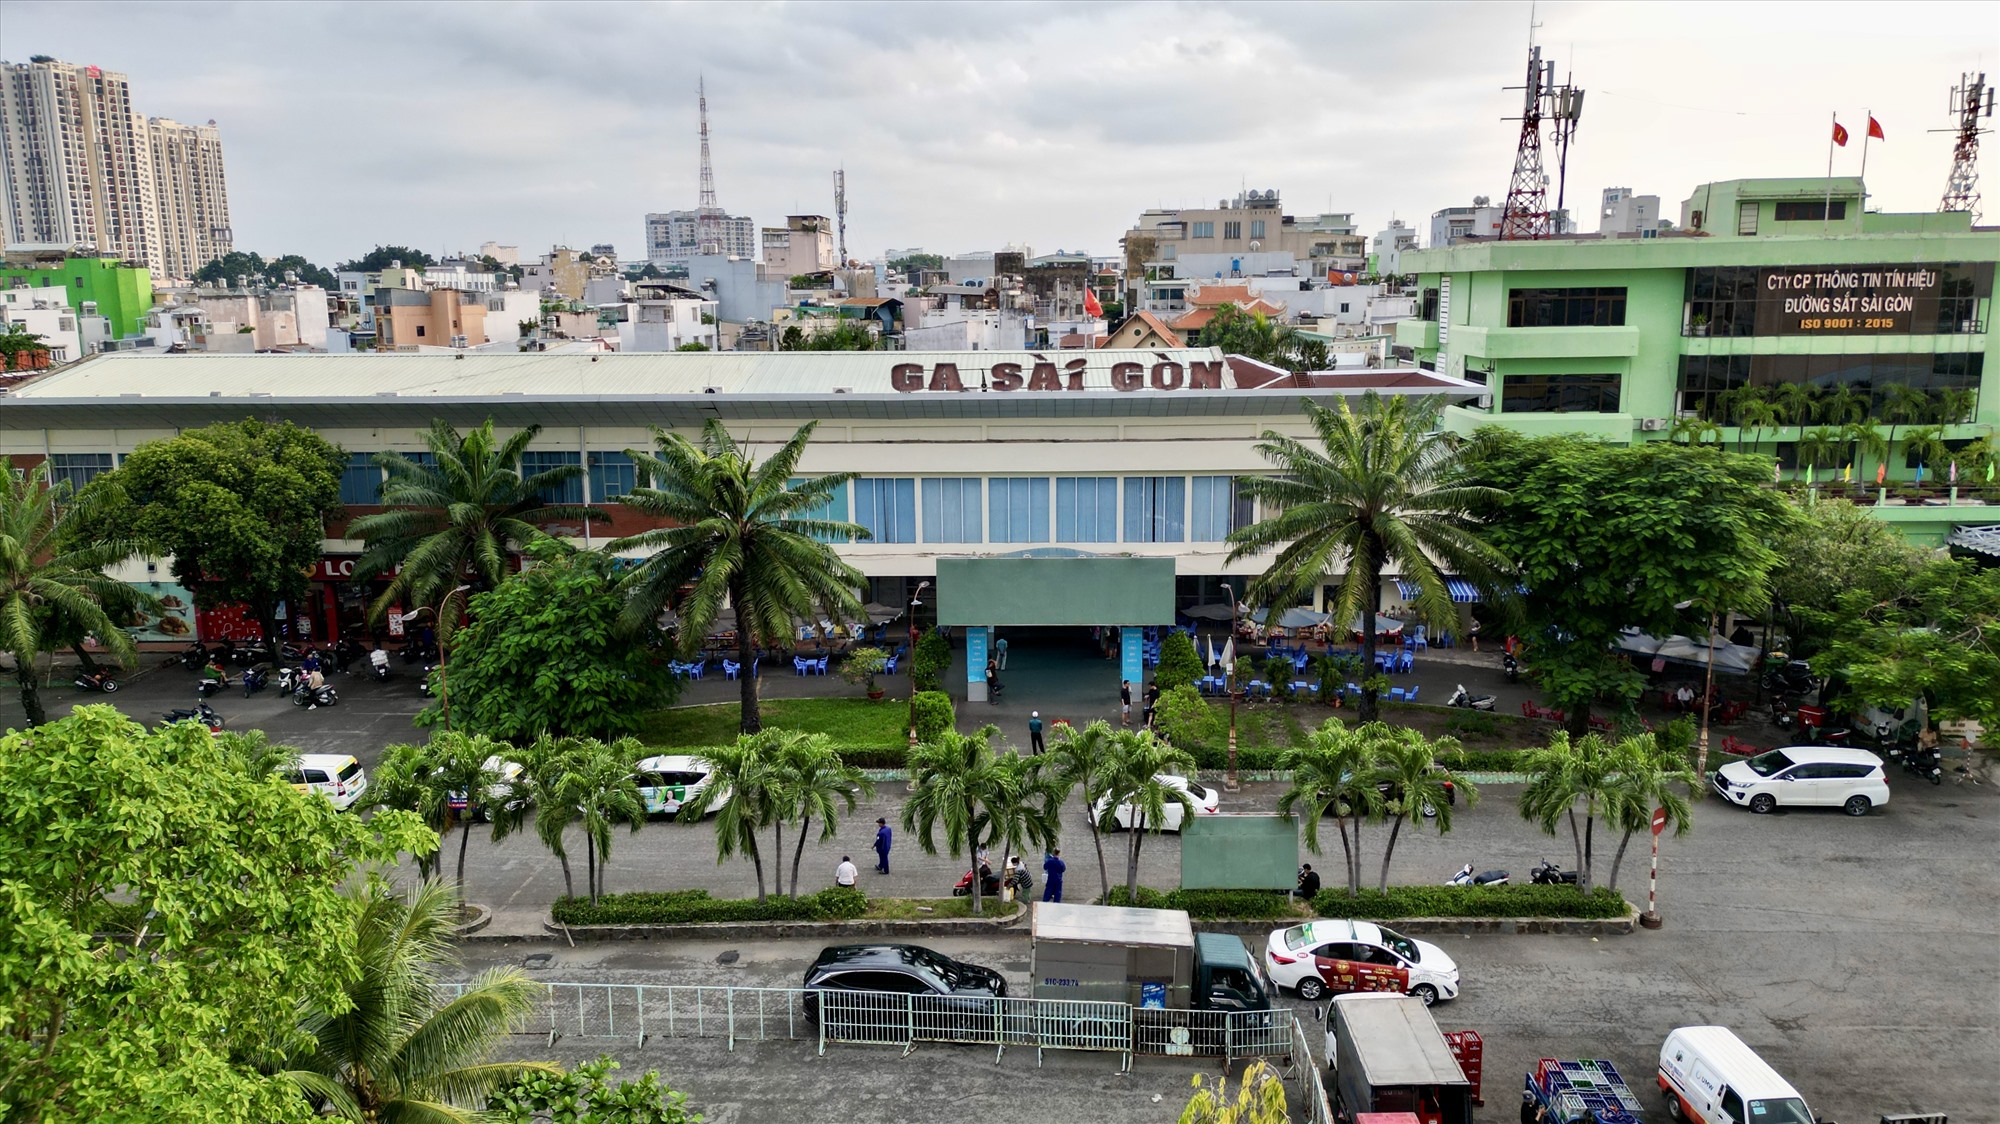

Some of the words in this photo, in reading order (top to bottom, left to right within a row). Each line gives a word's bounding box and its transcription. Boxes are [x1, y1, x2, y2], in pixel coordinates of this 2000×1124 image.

[1793, 273, 1811, 289] CP
[1815, 269, 1858, 289] THÔNG
[1861, 272, 1882, 288] TIN
[1885, 269, 1905, 288] TÍN
[1906, 269, 1936, 291] HIỆU
[1784, 293, 1830, 313] ĐƯỜNG
[1832, 291, 1858, 313] SẮT
[1861, 293, 1882, 313] SÀI
[1885, 292, 1913, 312] GÒN
[1800, 318, 1821, 329] ISO
[1824, 318, 1853, 329] 9001
[1864, 318, 1894, 328] 2015
[891, 362, 964, 392] GA
[1111, 352, 1224, 391] GÒN
